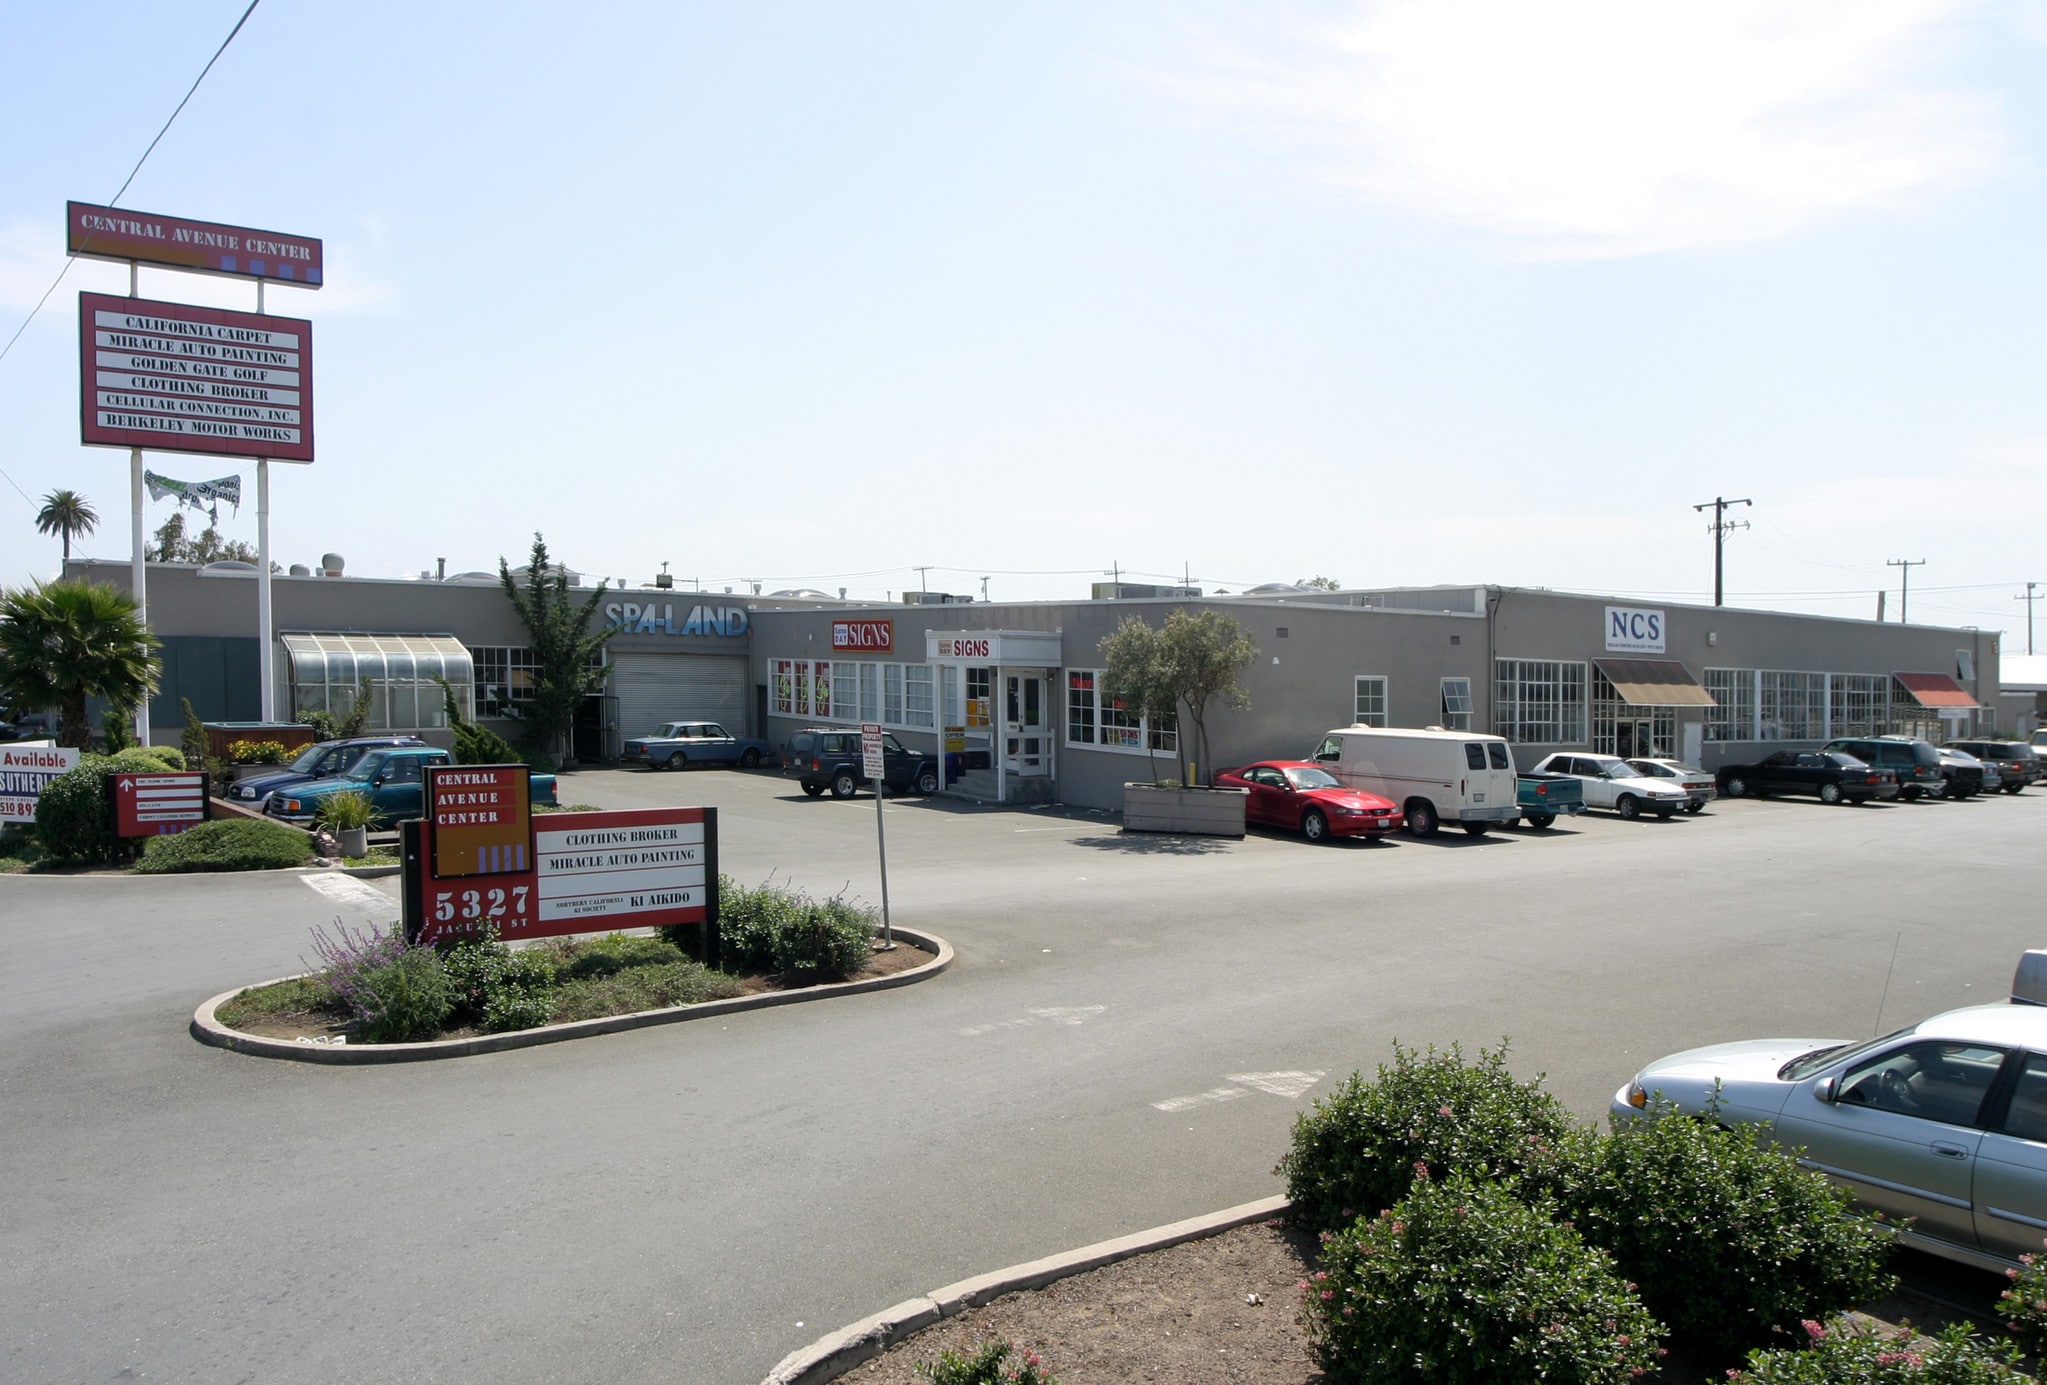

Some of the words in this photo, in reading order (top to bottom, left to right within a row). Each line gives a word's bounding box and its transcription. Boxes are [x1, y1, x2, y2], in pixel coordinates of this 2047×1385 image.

[81, 214, 166, 240] CENTRAL
[172, 228, 239, 250] AVENUE
[245, 239, 311, 261] CENTER
[125, 316, 213, 338] CALIFORNIA
[217, 327, 272, 344] CARPET
[109, 334, 175, 353] MIRACLE
[179, 342, 217, 357] AUTO
[221, 347, 287, 365] PAINTING
[131, 356, 188, 374] GOLDEN
[192, 363, 228, 378] GATE
[233, 367, 269, 381] GOLF
[131, 376, 205, 395] CLOTHING
[211, 384, 269, 401] BROKER
[106, 394, 176, 411] CELLULAR
[179, 401, 265, 421] CONNECTION,
[268, 410, 294, 422] INC.
[106, 413, 185, 432] BERKELEY
[191, 421, 238, 436] MOTOR
[243, 425, 292, 441] WORKS
[604, 602, 748, 637] SPA-LAND
[1611, 611, 1660, 641] NCS
[834, 635, 848, 643] DAY
[849, 623, 890, 647] SIGNS
[954, 639, 989, 657] SIGNS
[4, 751, 67, 768] Available
[437, 773, 497, 786] CENTRAL
[0, 802, 15, 813] 510
[438, 793, 498, 805] AVENUE
[438, 811, 498, 825] CENTER
[566, 831, 627, 846] CLOTHING
[630, 829, 678, 842] BROKER
[550, 856, 603, 870] MIRACLE
[607, 853, 638, 865] AUTO
[641, 849, 695, 862] PAINTING
[435, 886, 529, 921] 5327
[556, 900, 588, 908] NORTHERN
[589, 897, 624, 905] CALIFORNIA
[630, 896, 644, 907] KI
[648, 892, 690, 906] AIKIDO
[511, 918, 528, 928] ST
